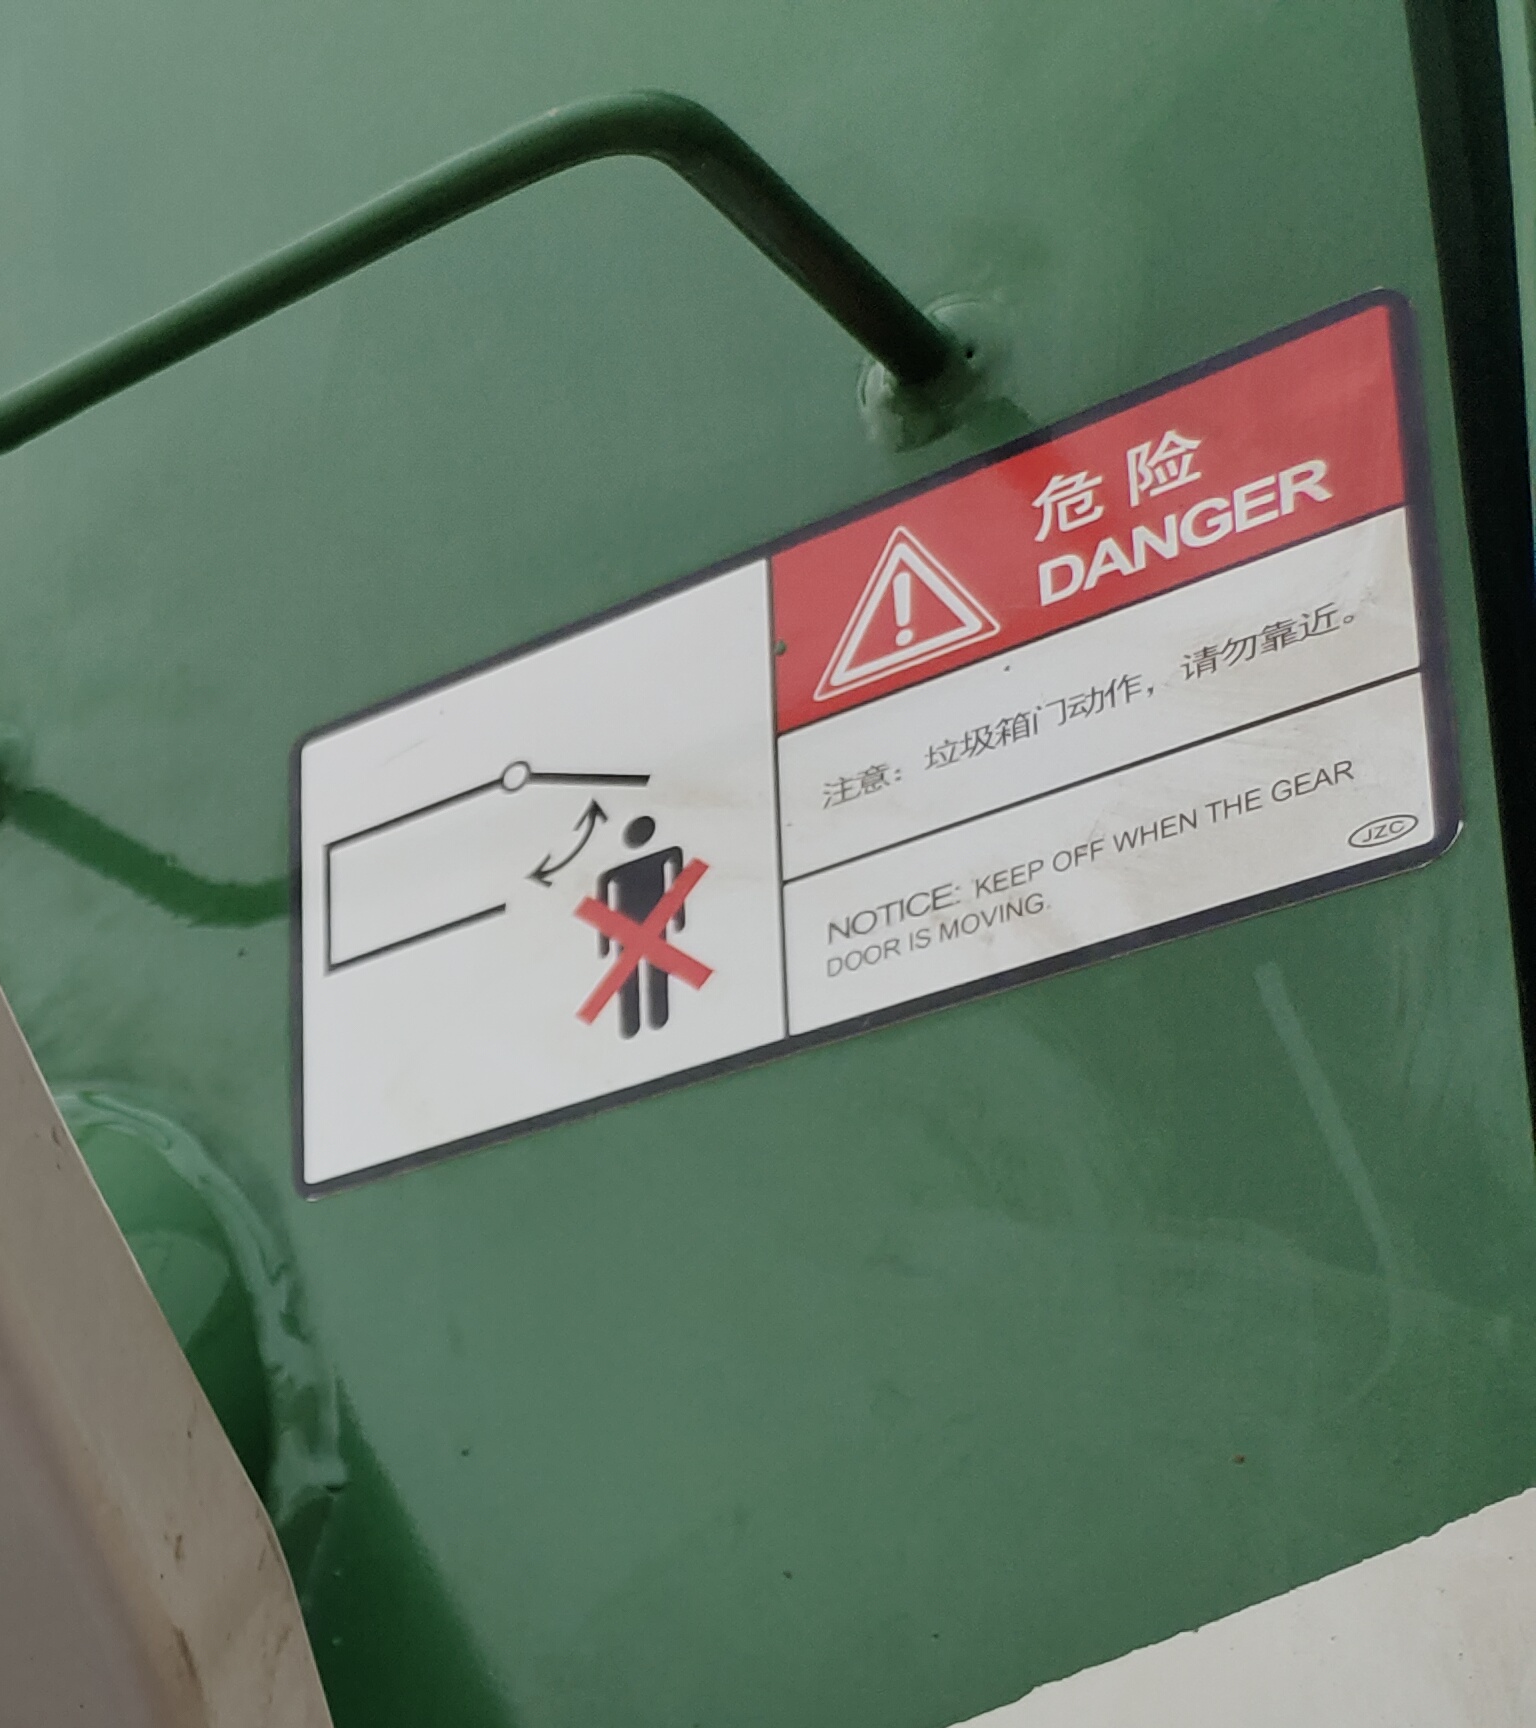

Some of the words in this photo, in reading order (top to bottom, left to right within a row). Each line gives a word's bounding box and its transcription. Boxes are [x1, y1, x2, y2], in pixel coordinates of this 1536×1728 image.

[1031, 429, 1203, 543] 危险
[1038, 459, 1334, 607] DANGER
[827, 882, 962, 945] NOTICE:
[974, 858, 1045, 899] KEEP
[1052, 838, 1105, 873] OFF
[1113, 808, 1198, 853] WHEN
[1205, 788, 1263, 825] THE
[1271, 760, 1355, 802] GEAR
[1360, 819, 1406, 844] JZC
[826, 938, 902, 978] DOOR
[909, 928, 932, 952] IS
